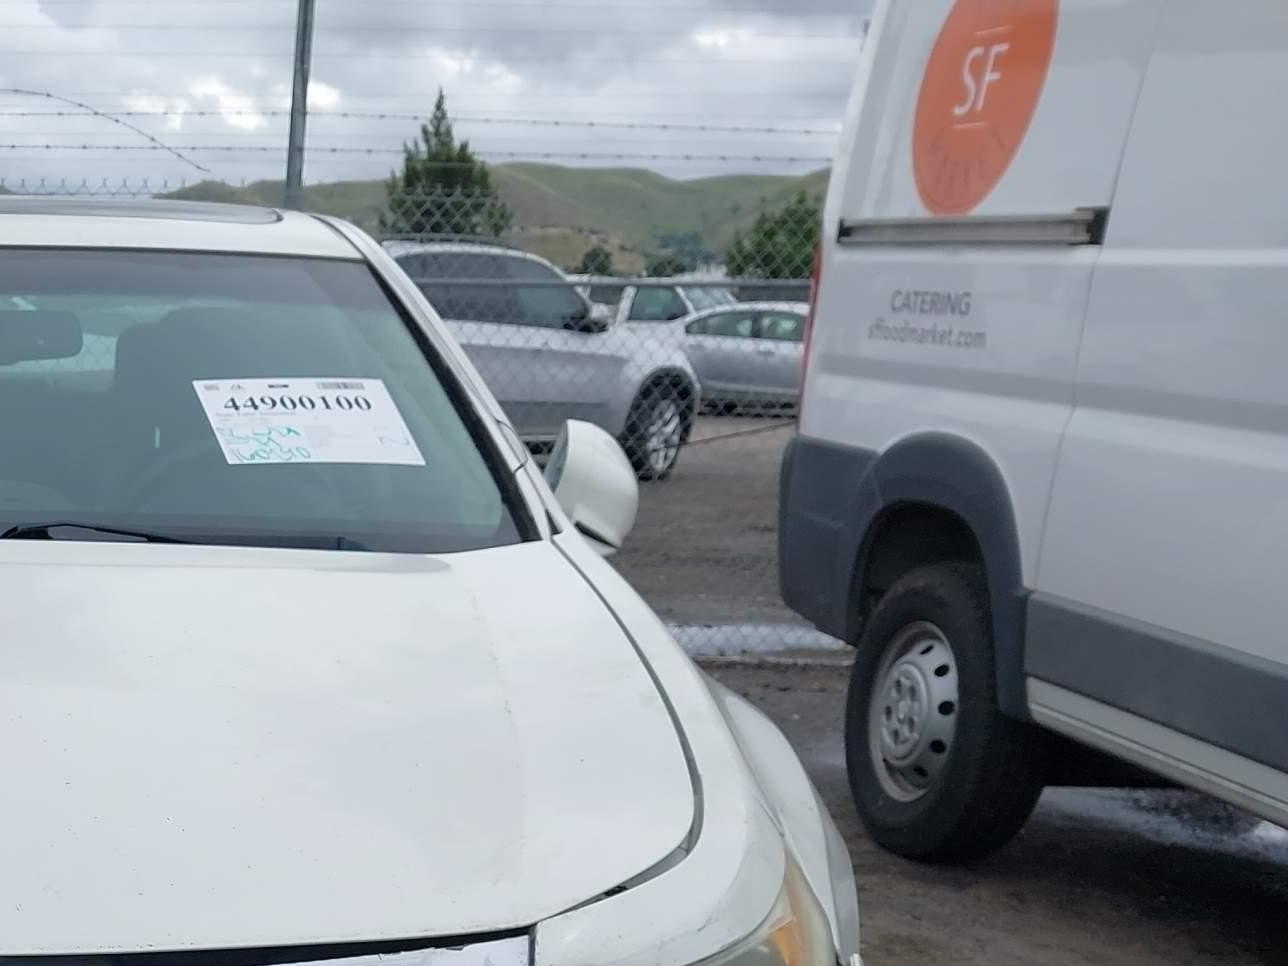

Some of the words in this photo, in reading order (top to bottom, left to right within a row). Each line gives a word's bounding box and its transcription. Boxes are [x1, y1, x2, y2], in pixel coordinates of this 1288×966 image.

[953, 43, 1010, 116] SF
[889, 289, 972, 316] CATERING
[223, 394, 373, 412] 44900100
